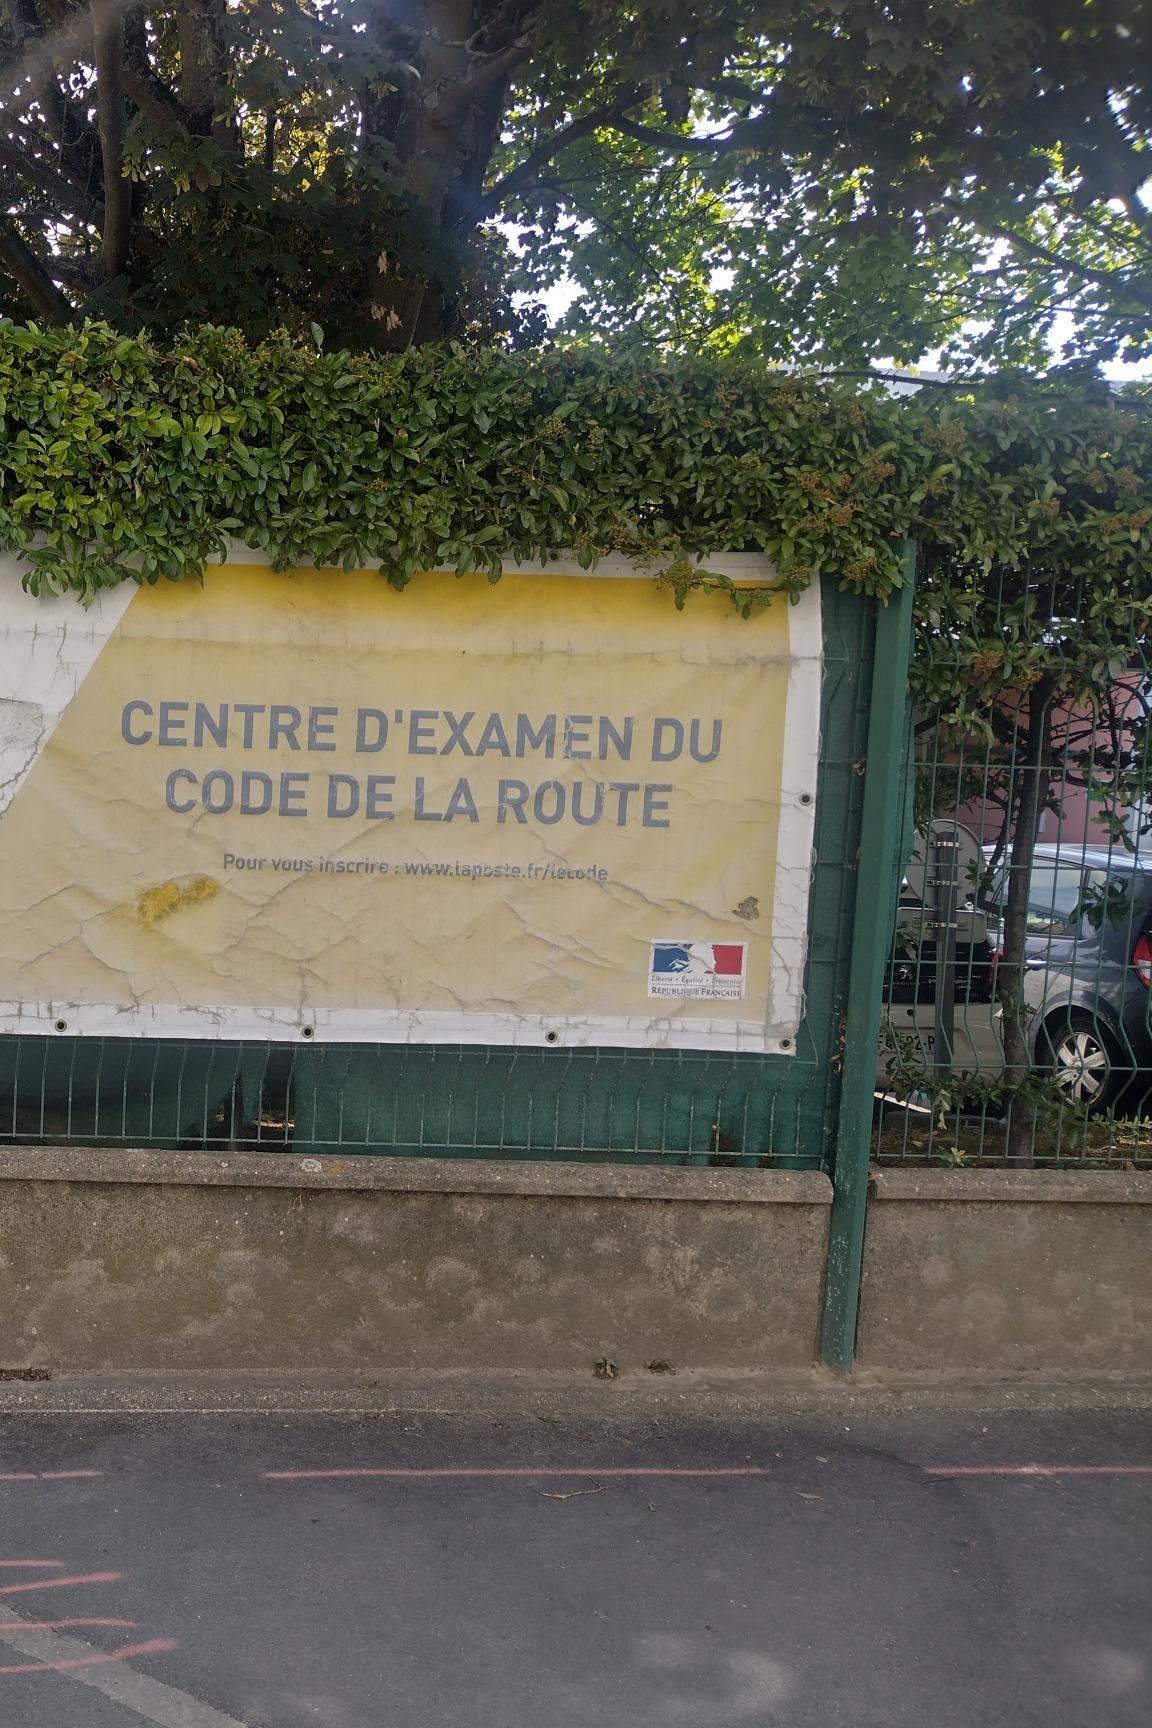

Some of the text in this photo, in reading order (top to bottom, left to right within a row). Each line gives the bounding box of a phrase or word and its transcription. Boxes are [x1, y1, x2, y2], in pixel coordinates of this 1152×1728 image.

[120, 700, 723, 763] CENTRE D'EXAMEN DU
[165, 769, 674, 828] CODE DE LA ROUTE
[223, 853, 266, 870] Pour
[271, 858, 314, 872] vous
[319, 856, 389, 874] inscrire
